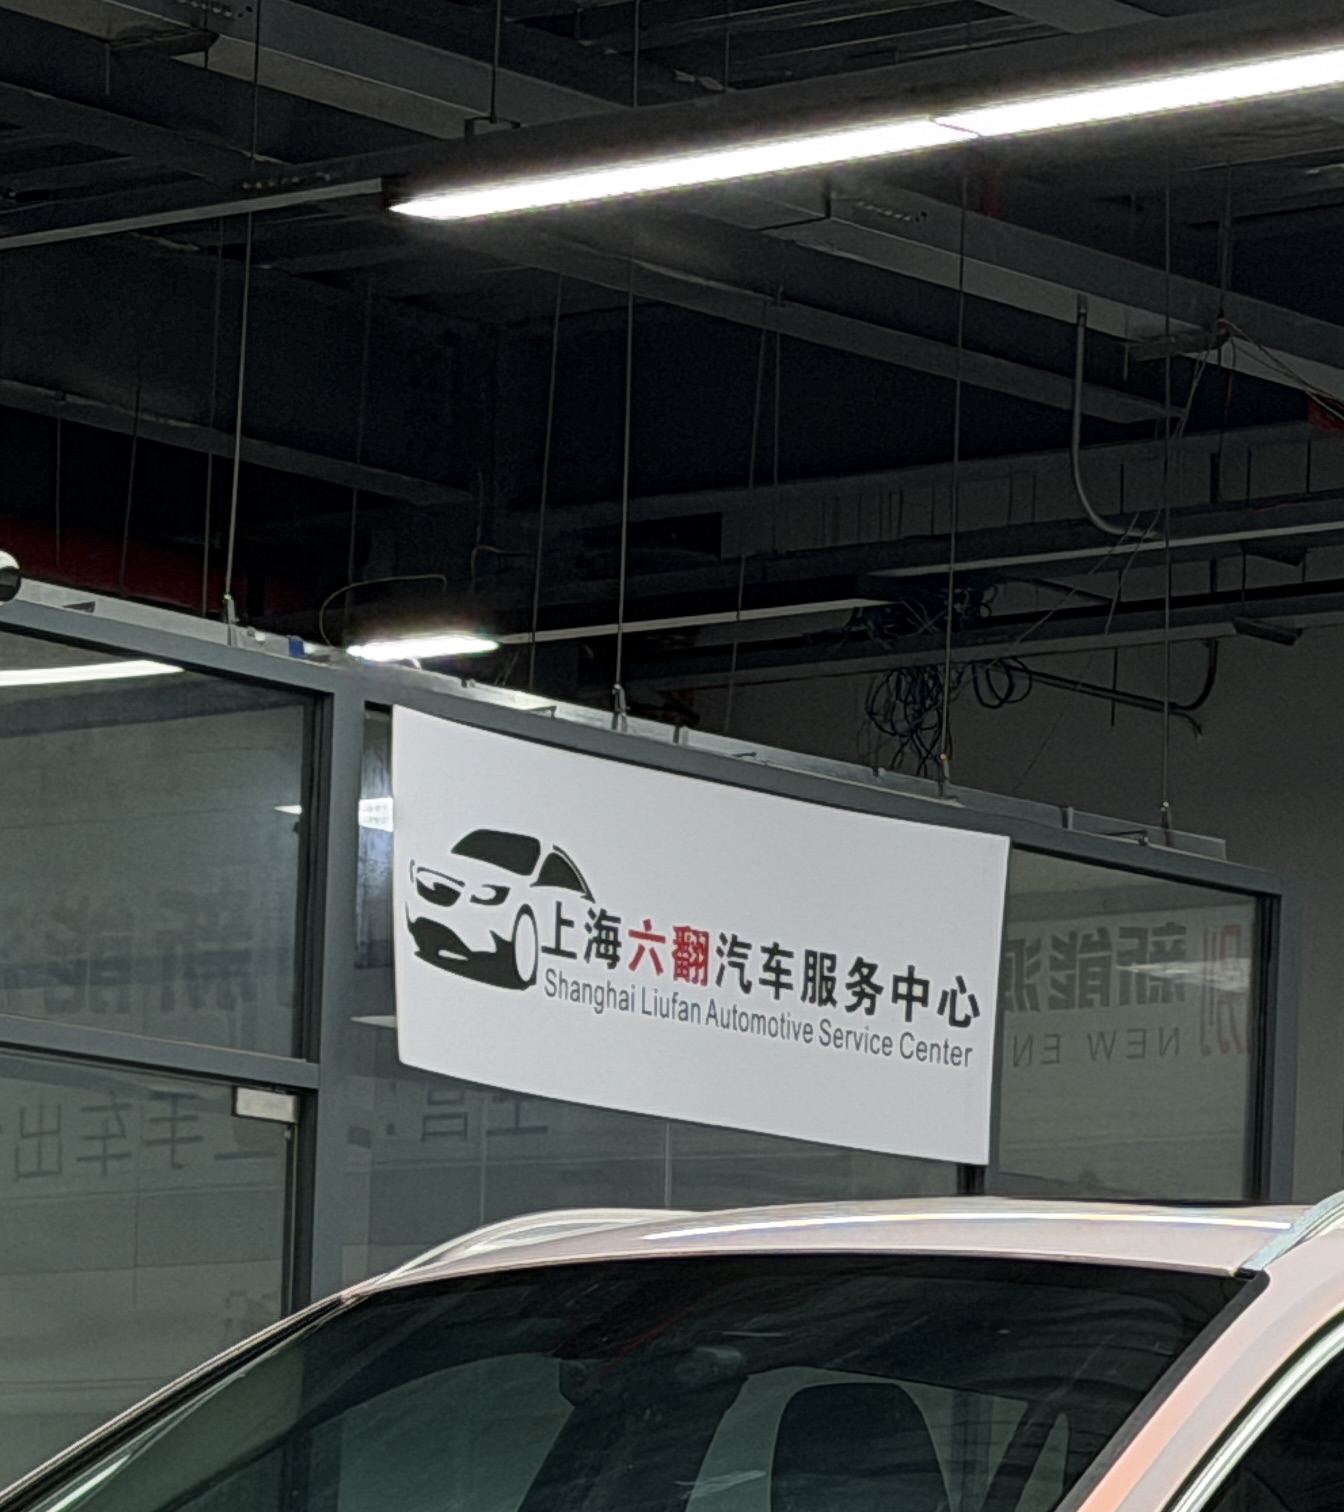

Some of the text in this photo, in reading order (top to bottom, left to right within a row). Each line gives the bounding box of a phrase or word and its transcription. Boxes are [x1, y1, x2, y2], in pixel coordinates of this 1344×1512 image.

[541, 900, 980, 1030] 上海六翻汽车服务中心
[544, 968, 973, 1070] Shanghai Liufan Automotive Service Center
